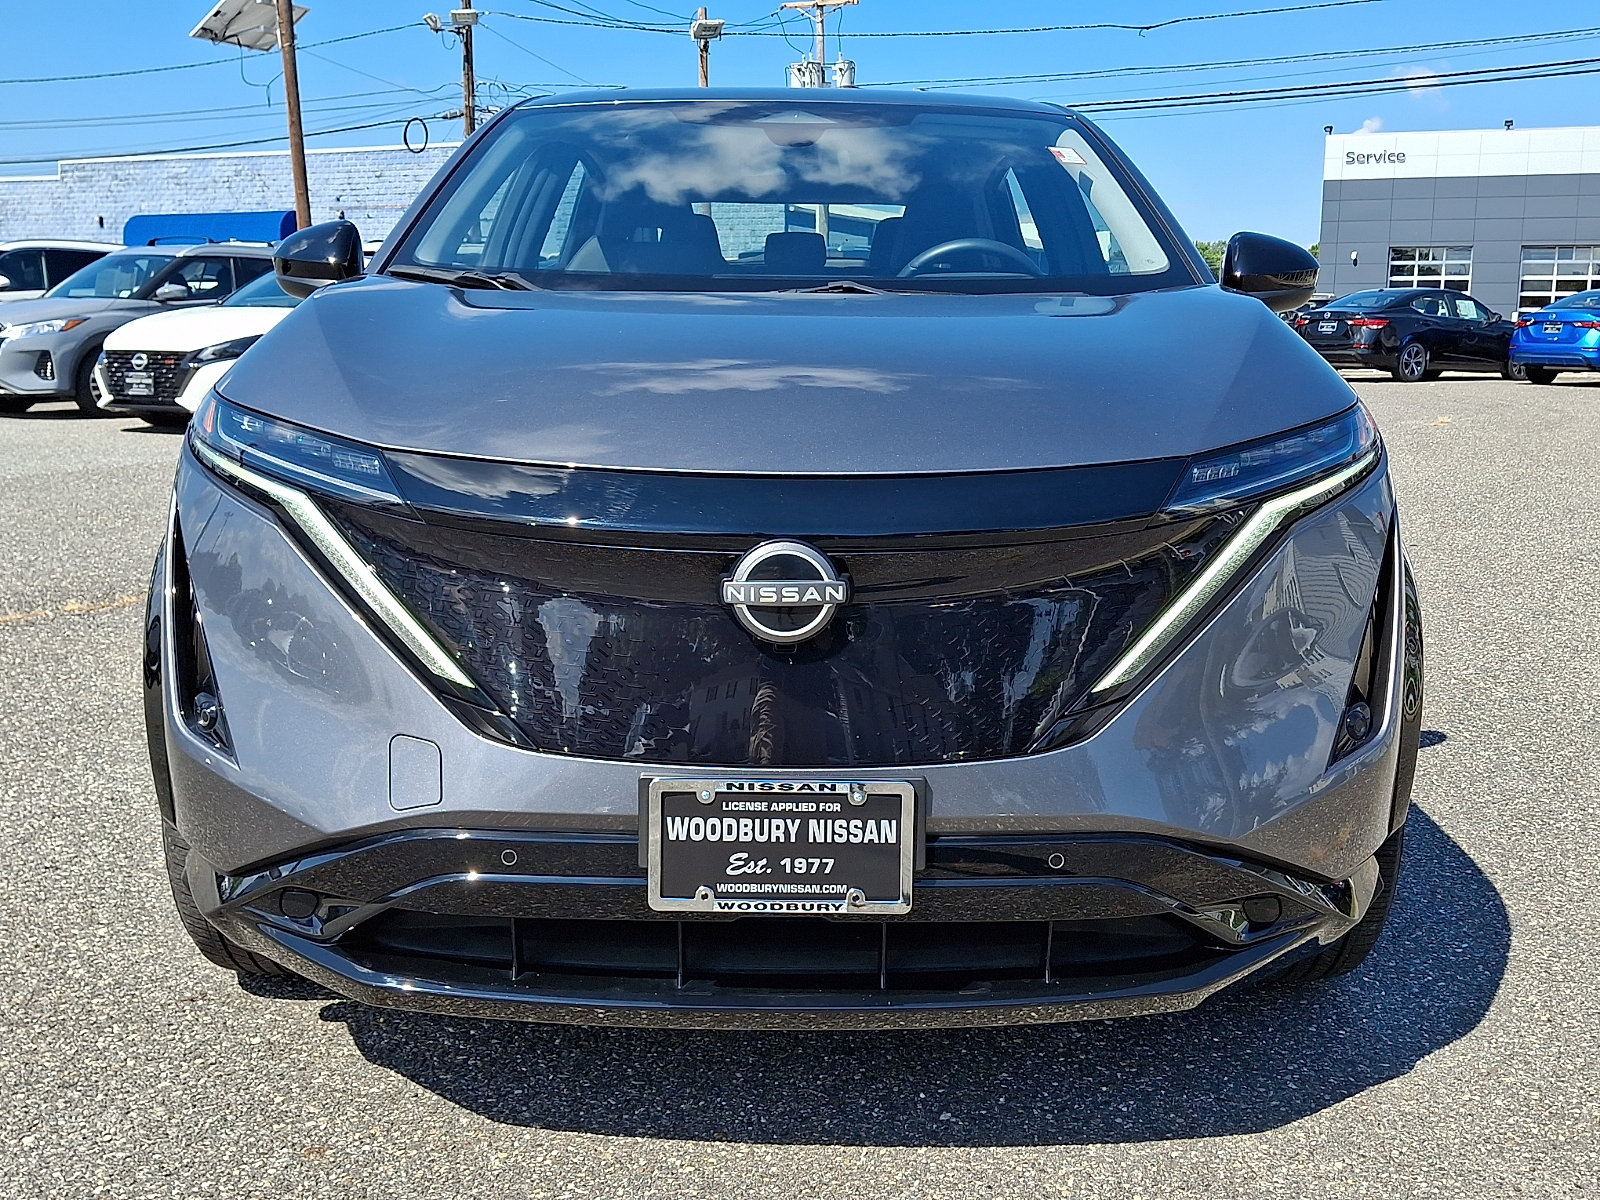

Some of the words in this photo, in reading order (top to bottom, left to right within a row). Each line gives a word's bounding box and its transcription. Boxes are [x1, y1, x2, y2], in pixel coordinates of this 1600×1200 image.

[1346, 150, 1406, 165] Service
[727, 585, 843, 602] NISSAN
[726, 782, 837, 792] NISSAN
[722, 801, 768, 812] LICENSE
[770, 803, 816, 812] APPLIED
[819, 803, 841, 812] FOR
[666, 816, 801, 842] WOODBURY
[808, 819, 897, 843] NISSAN
[726, 852, 772, 875] Est.
[780, 858, 835, 874] 1977
[716, 883, 847, 894] WOODBURYNISSAN.COM
[717, 902, 844, 912] WOODBURY
